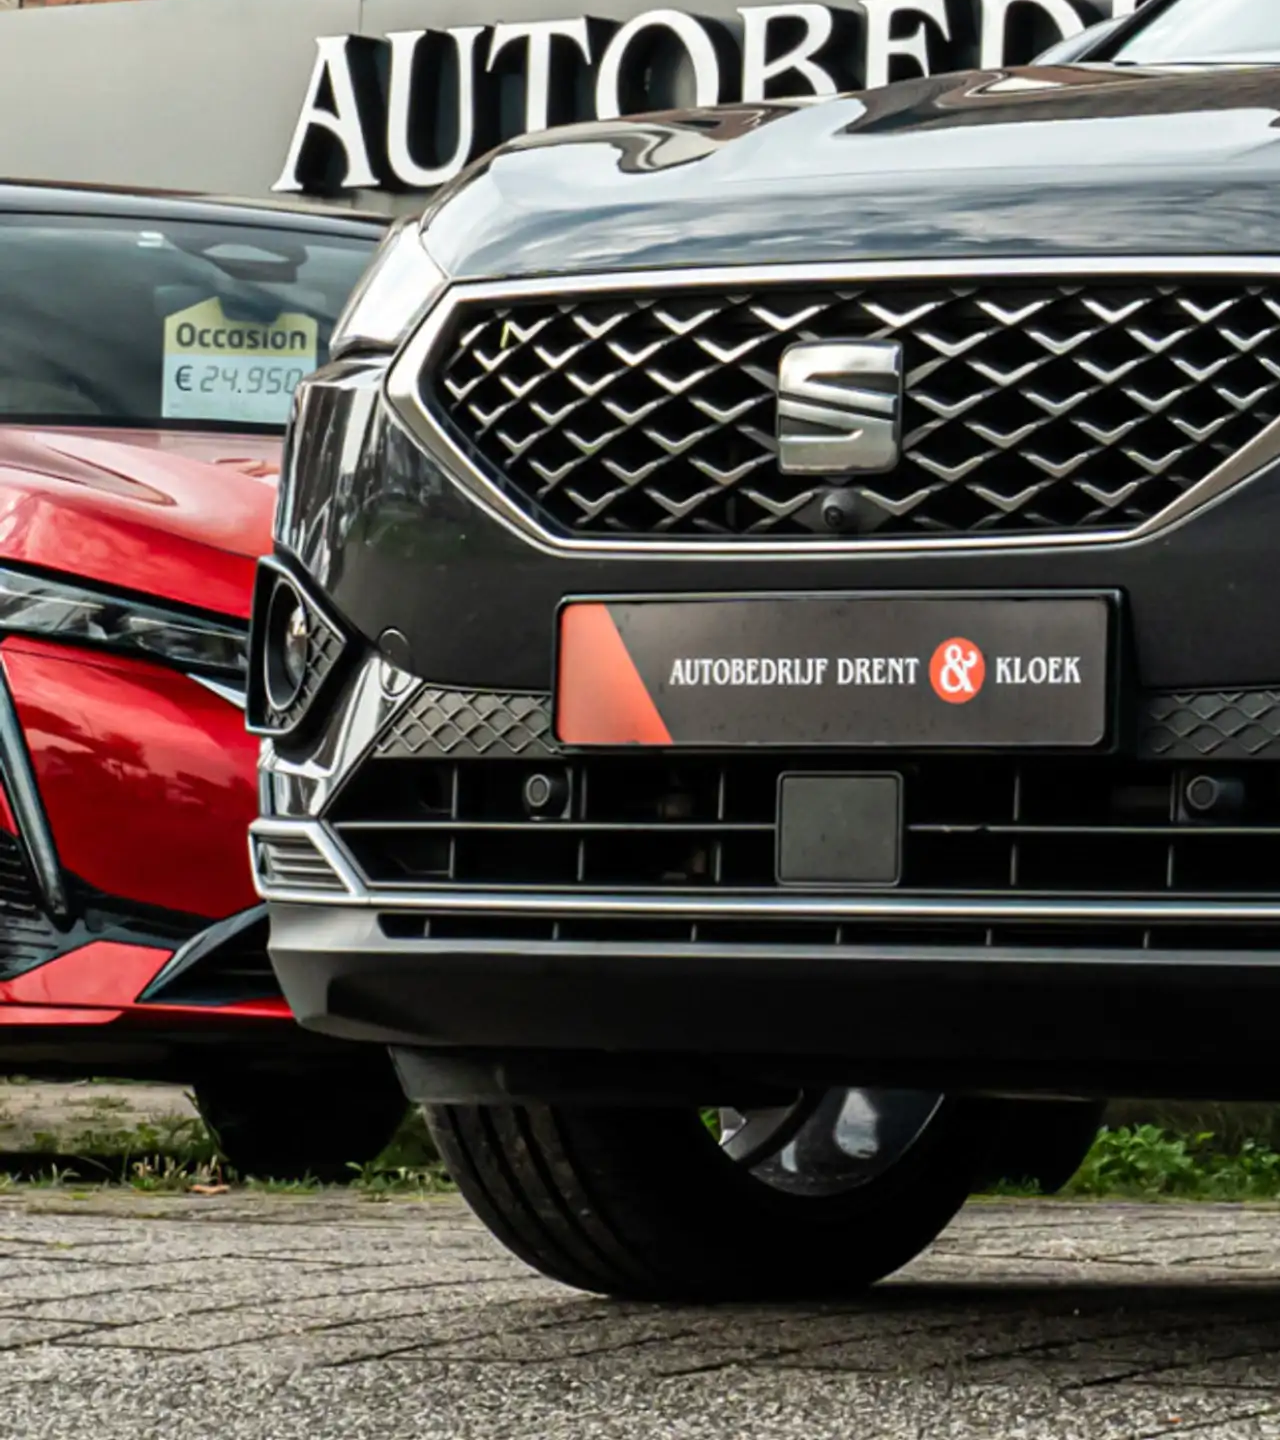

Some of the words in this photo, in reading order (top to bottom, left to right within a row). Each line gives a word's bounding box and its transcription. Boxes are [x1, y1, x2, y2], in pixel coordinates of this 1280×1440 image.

[175, 321, 308, 351] Occasion
[669, 657, 829, 686] AUTOBEDRIJF
[836, 657, 920, 686] DRENT
[940, 643, 978, 693] &
[995, 655, 1082, 685] KLOEK
